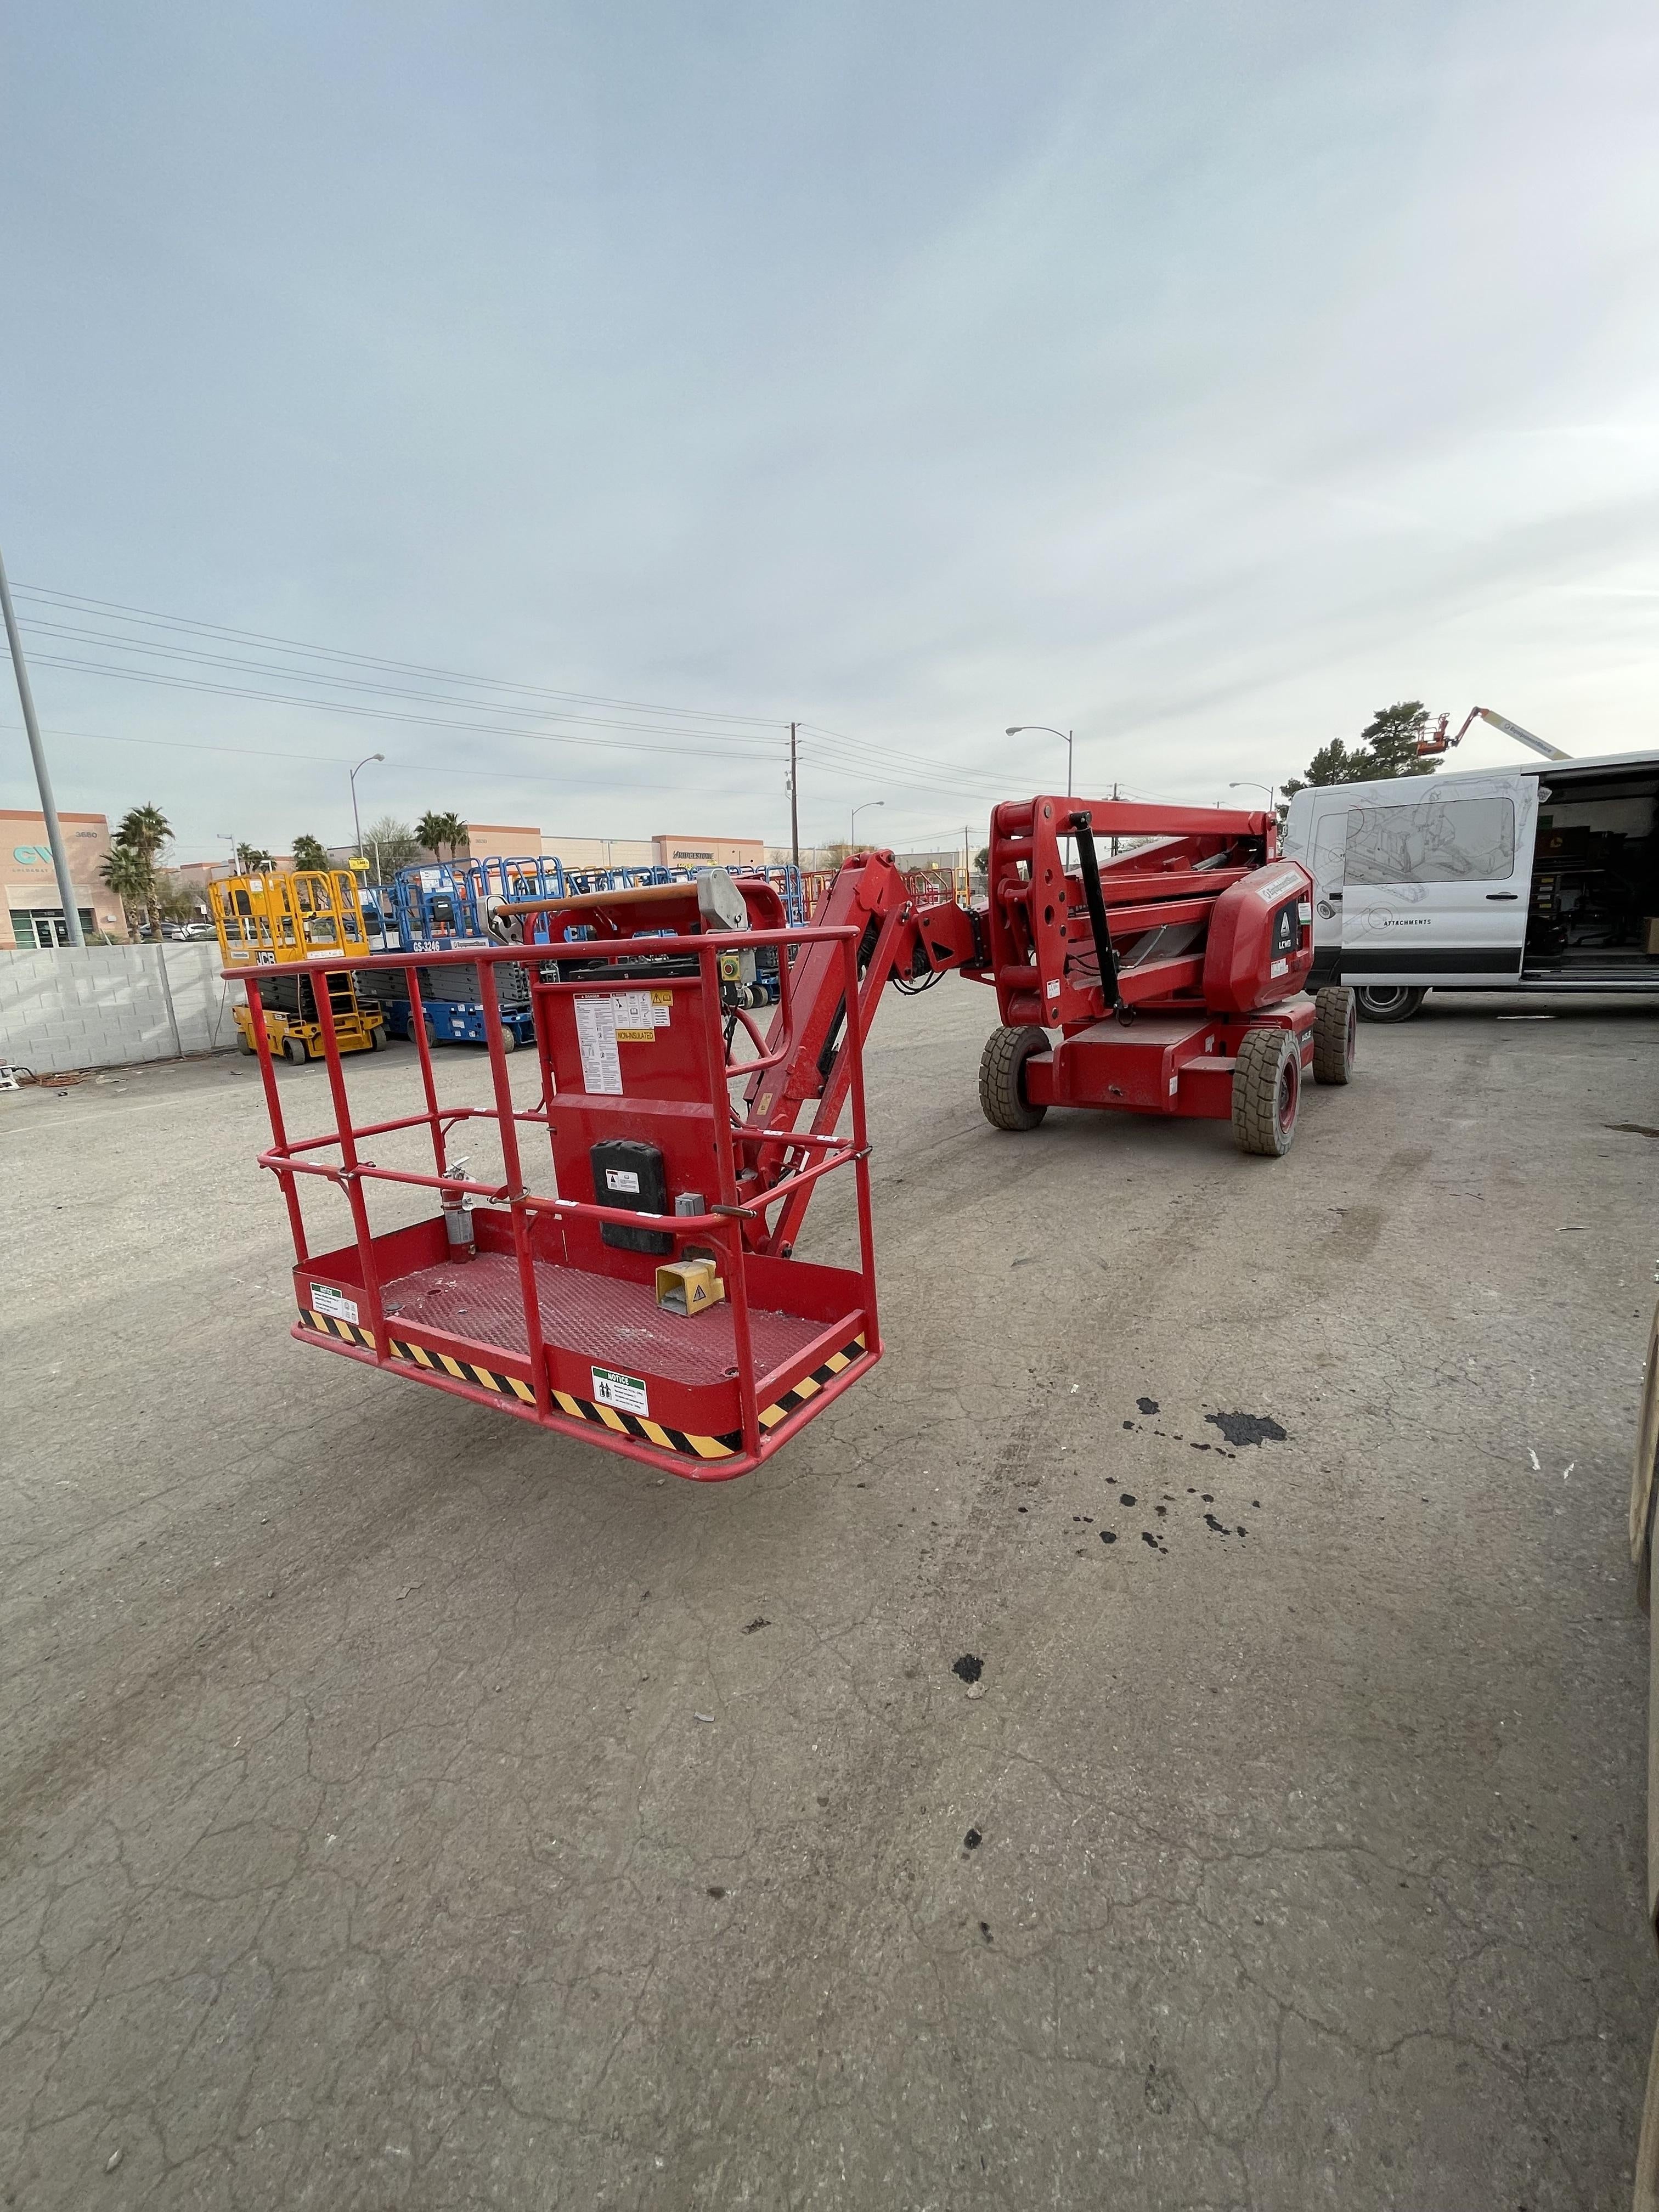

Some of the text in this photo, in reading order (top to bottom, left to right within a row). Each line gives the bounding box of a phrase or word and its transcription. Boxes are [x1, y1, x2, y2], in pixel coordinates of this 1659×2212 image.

[413, 940, 440, 952] GS-3246
[257, 951, 276, 966] JCB
[618, 1031, 653, 1040] NON-INSULATED
[607, 1373, 629, 1385] NOTICE
